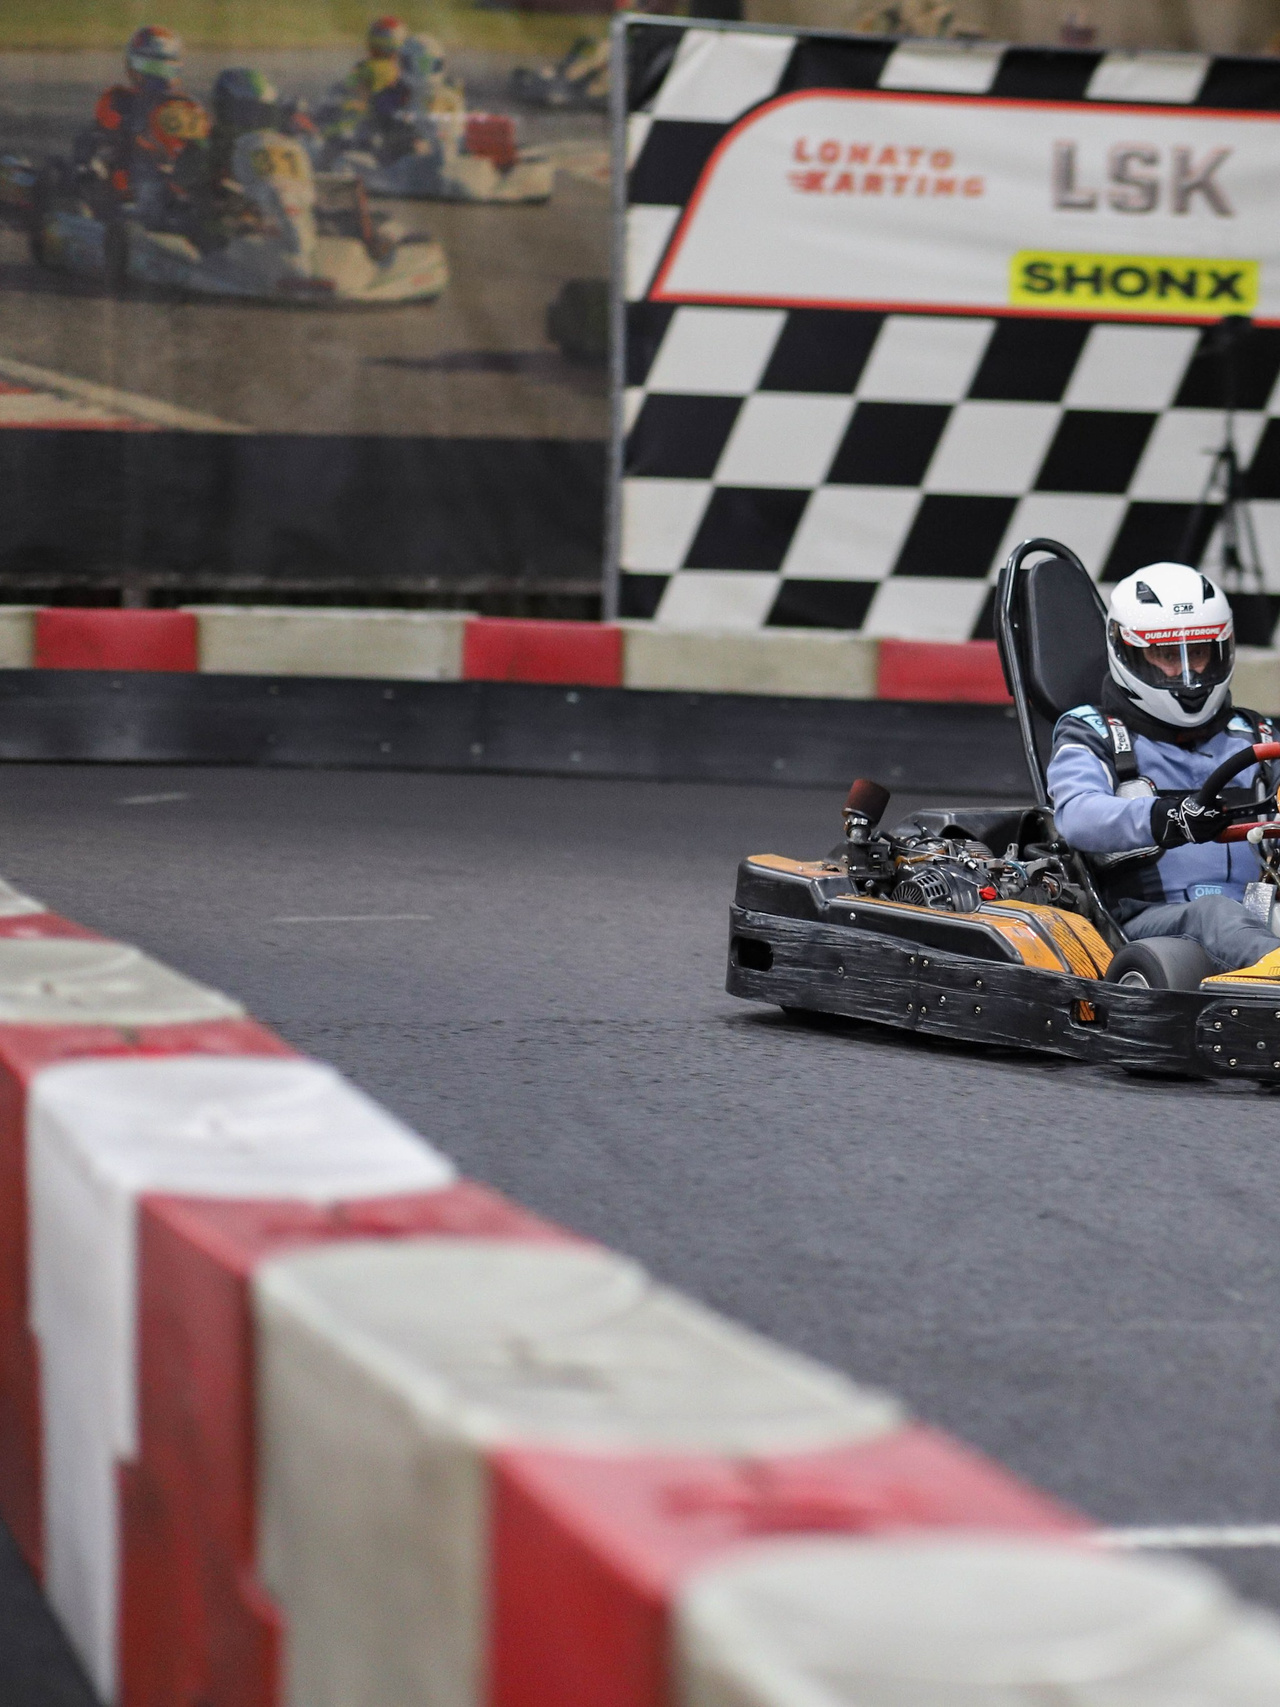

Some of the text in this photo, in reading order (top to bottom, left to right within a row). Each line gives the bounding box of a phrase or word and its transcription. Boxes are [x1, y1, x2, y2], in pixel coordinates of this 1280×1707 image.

[793, 136, 954, 170] LONATO
[789, 171, 984, 198] KARTING
[1053, 140, 1234, 217] LSK
[1022, 260, 1245, 300] SHONX
[1145, 627, 1220, 640] DUBAI KARTDROME
